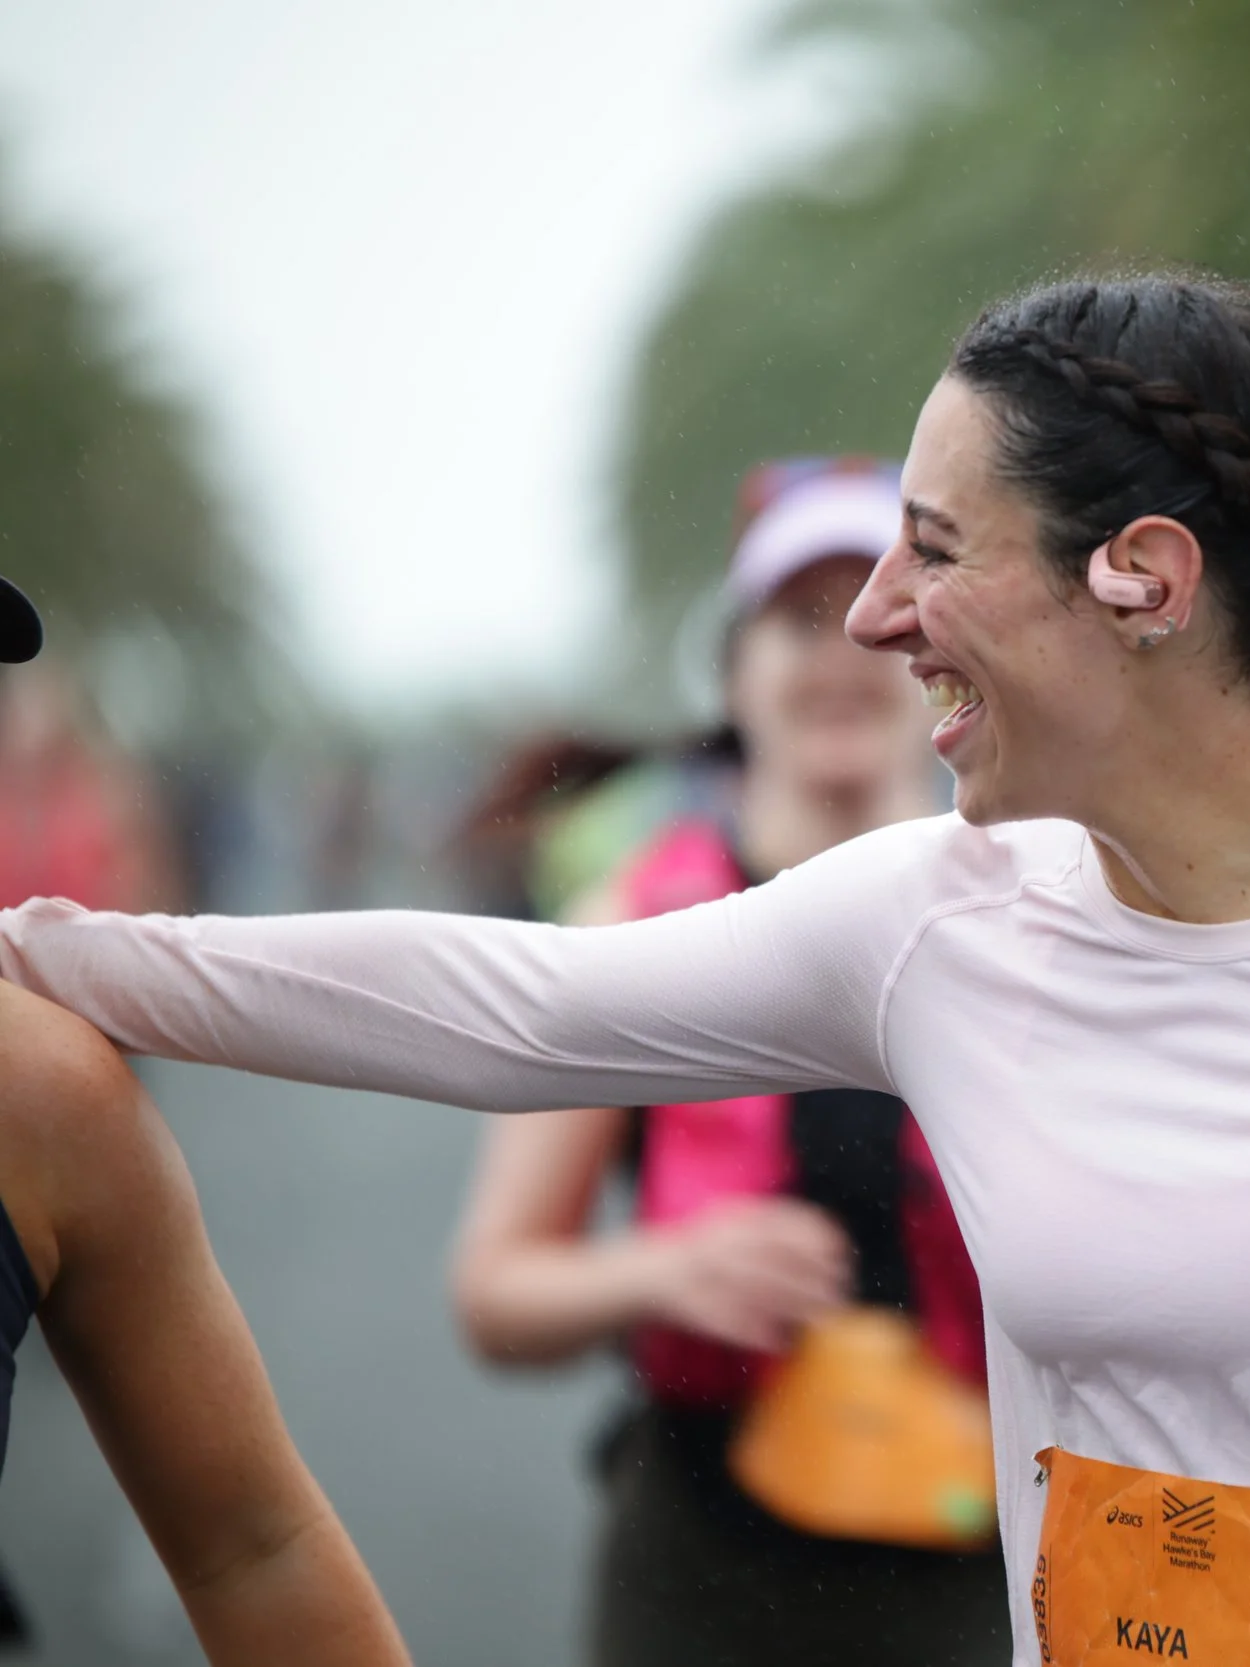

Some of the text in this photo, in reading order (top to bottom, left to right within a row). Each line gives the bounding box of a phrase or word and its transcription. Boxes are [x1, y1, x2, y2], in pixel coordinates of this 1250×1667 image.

[1118, 1511, 1144, 1528] asics
[1170, 1531, 1209, 1549] Runaway
[1162, 1542, 1216, 1562] Hawke's Bay
[1170, 1556, 1211, 1572] Marathon
[1117, 1616, 1188, 1660] KAYA
